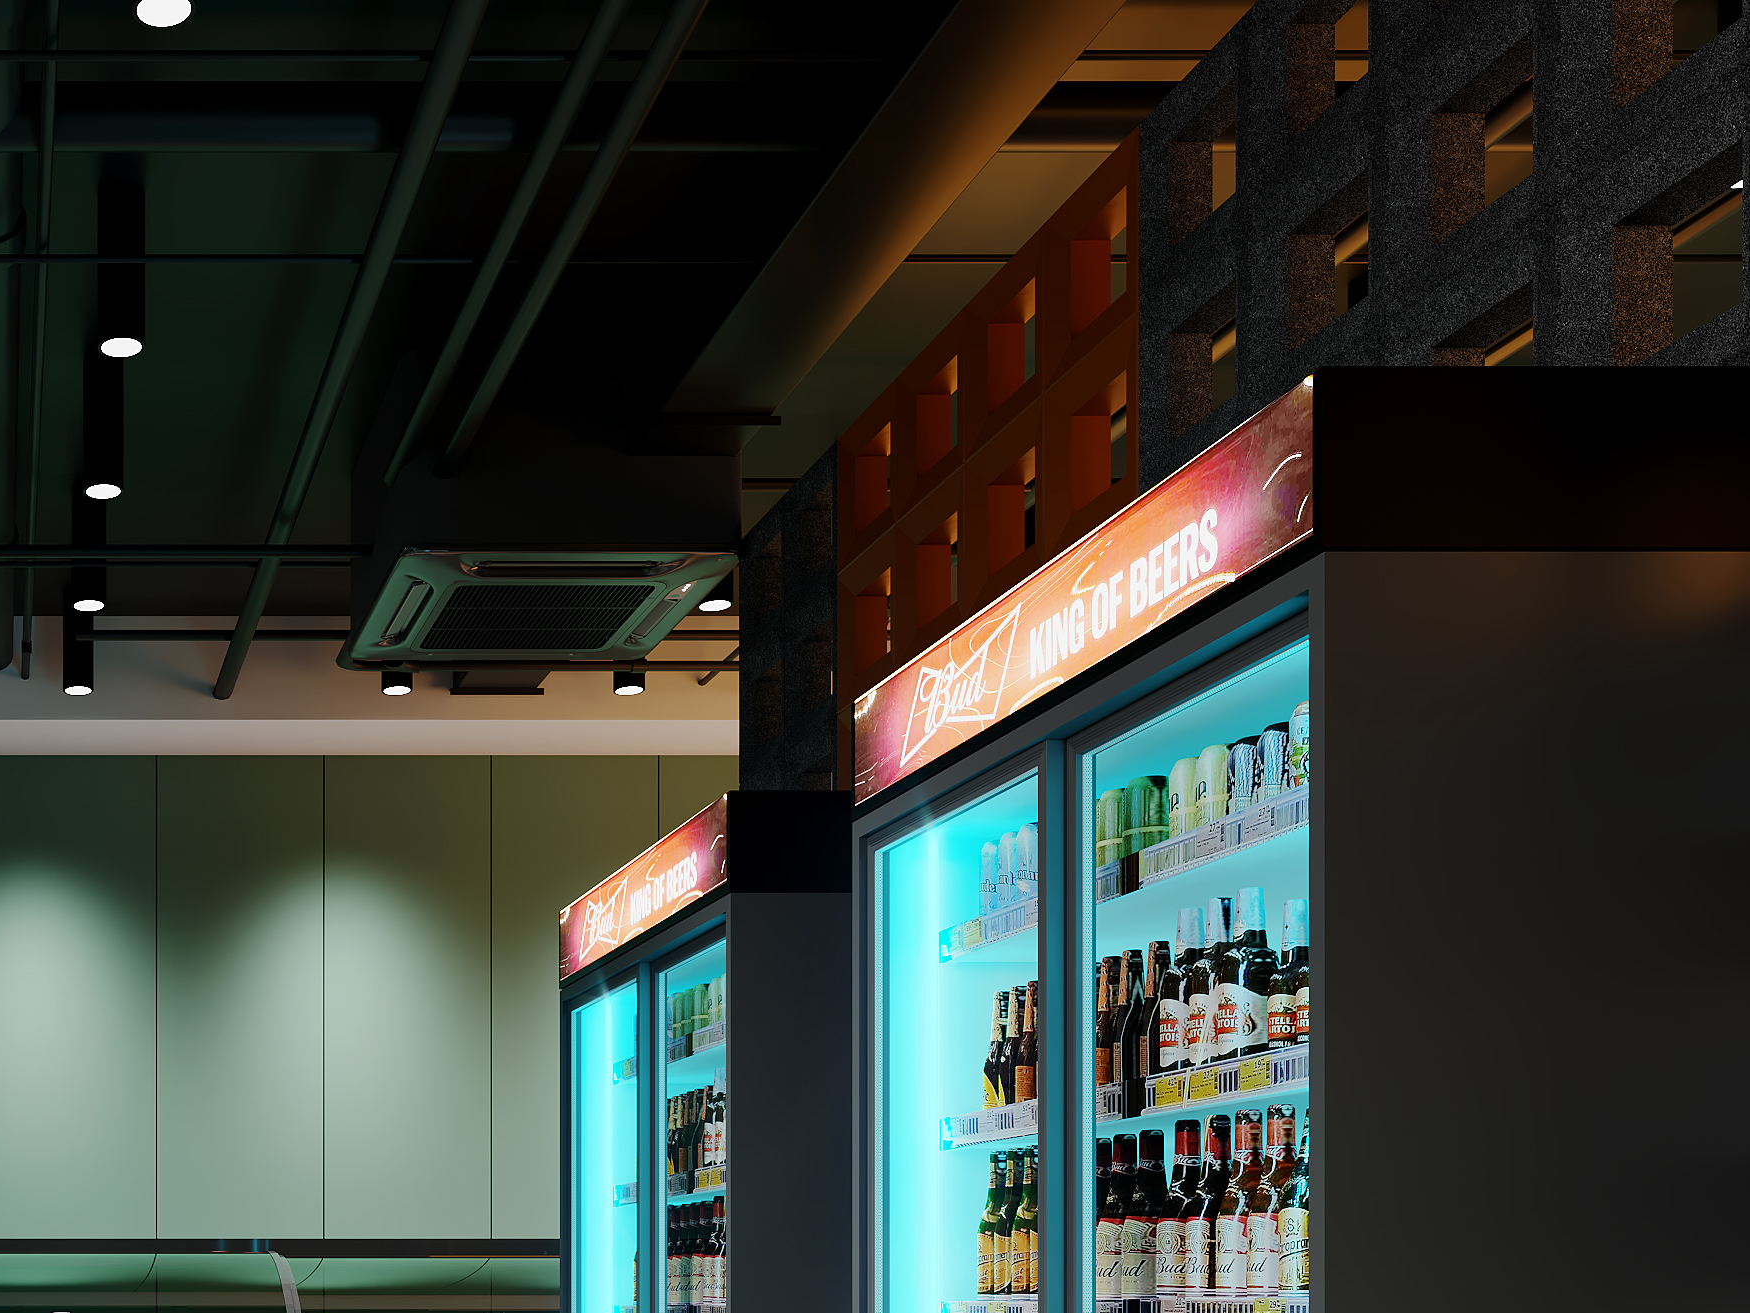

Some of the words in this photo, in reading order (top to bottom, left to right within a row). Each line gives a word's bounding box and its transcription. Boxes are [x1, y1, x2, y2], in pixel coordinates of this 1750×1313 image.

[1029, 602, 1085, 680] KING
[1091, 570, 1123, 640] OF
[1129, 507, 1219, 620] BEERS
[919, 661, 987, 734] Bud
[587, 901, 615, 945] Bud
[630, 883, 652, 925] KING
[653, 873, 665, 911] OF
[666, 851, 698, 903] BEERS
